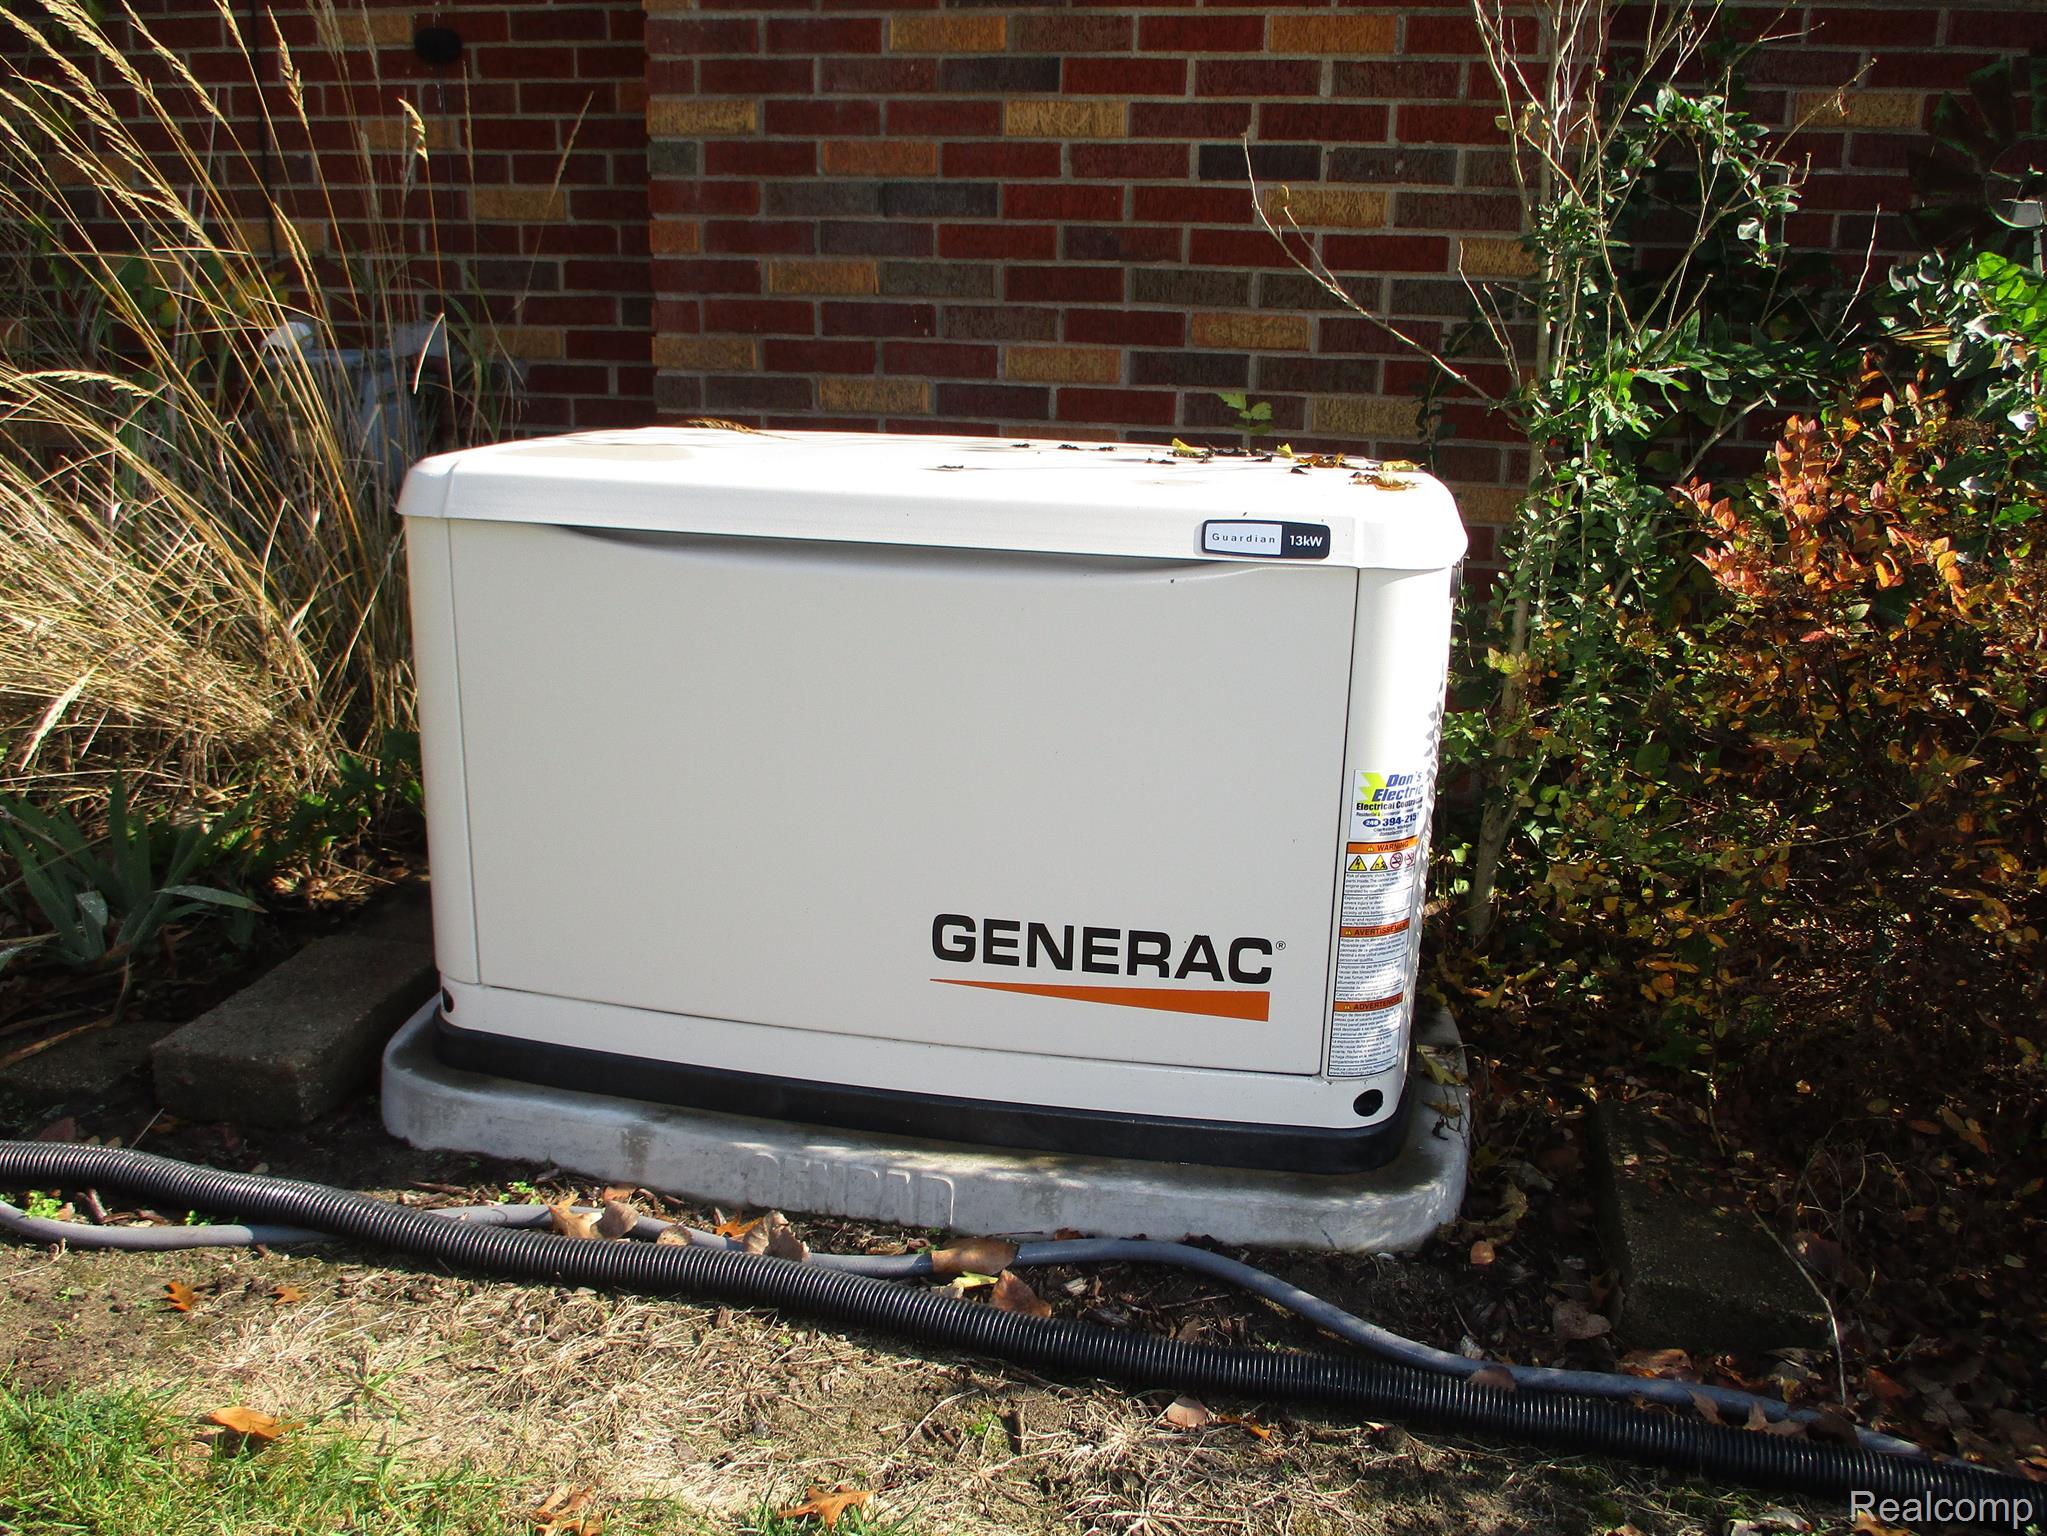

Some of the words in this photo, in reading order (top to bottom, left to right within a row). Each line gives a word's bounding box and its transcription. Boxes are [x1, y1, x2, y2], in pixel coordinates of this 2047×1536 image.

[1211, 532, 1276, 544] Guardian
[1289, 535, 1323, 547] 13kW
[1386, 771, 1422, 787] Don's
[1372, 783, 1423, 802] Electric
[1382, 812, 1419, 826] 394-215
[1377, 841, 1409, 851] WARNING
[931, 913, 1273, 985] GENERAC
